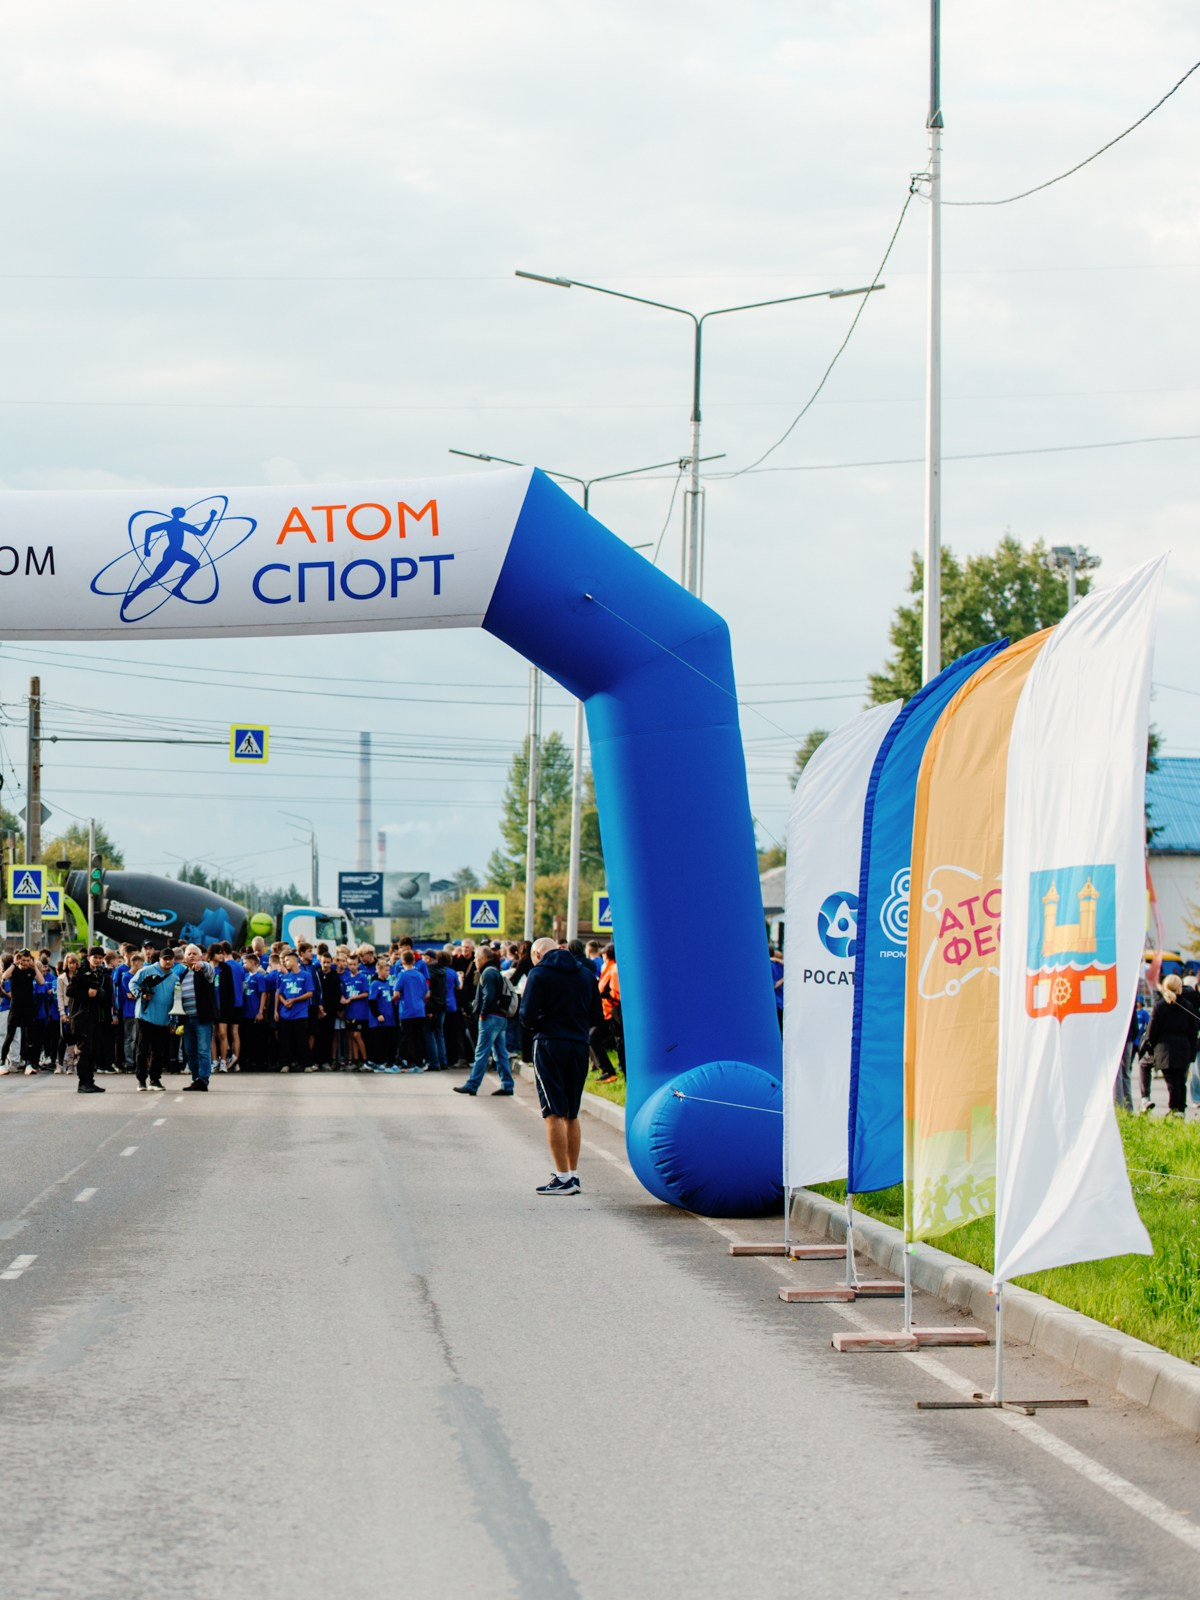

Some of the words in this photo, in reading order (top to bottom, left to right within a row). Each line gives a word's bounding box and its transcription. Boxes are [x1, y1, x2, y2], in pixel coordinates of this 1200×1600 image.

[275, 499, 439, 545] АТОМ
[252, 553, 454, 604] СПОРТ
[943, 922, 1002, 966] ФЕ
